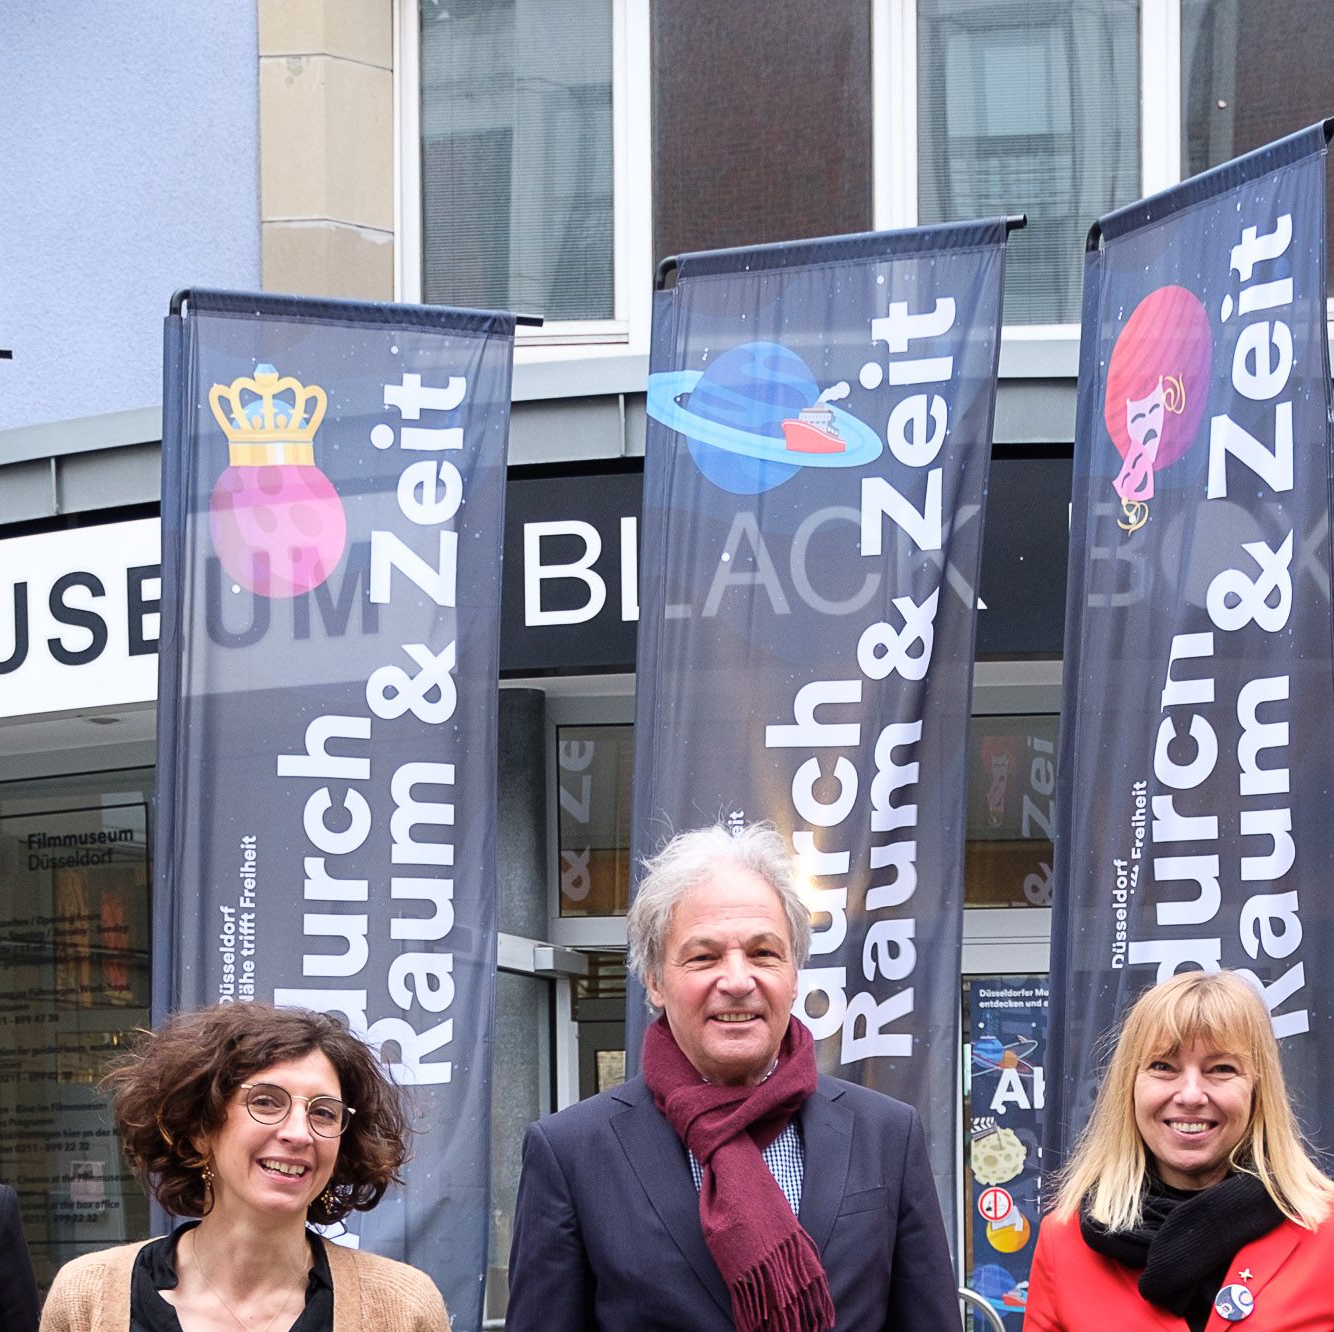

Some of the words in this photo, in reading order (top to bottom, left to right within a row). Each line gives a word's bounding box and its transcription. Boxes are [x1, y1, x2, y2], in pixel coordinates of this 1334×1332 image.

[1207, 214, 1293, 499] Zeit
[860, 298, 955, 556] Zeit
[370, 373, 466, 607] Zeit
[1207, 529, 1293, 632] &
[857, 587, 939, 680] &
[366, 640, 456, 724] &
[27, 828, 134, 850] Filmmuseum
[27, 848, 114, 872] Düsseldorf
[1131, 780, 1147, 860] Freiheit
[239, 835, 257, 908] Freiheit
[841, 720, 922, 1064] Raum
[1112, 859, 1129, 969] Düsseldorf
[239, 912, 256, 957] trifft
[367, 763, 454, 1085] Raum
[979, 988, 1034, 998] Düsseldorfer
[1035, 988, 1049, 997] Mu
[979, 999, 1025, 1009] entdecken
[1026, 999, 1042, 1008] und
